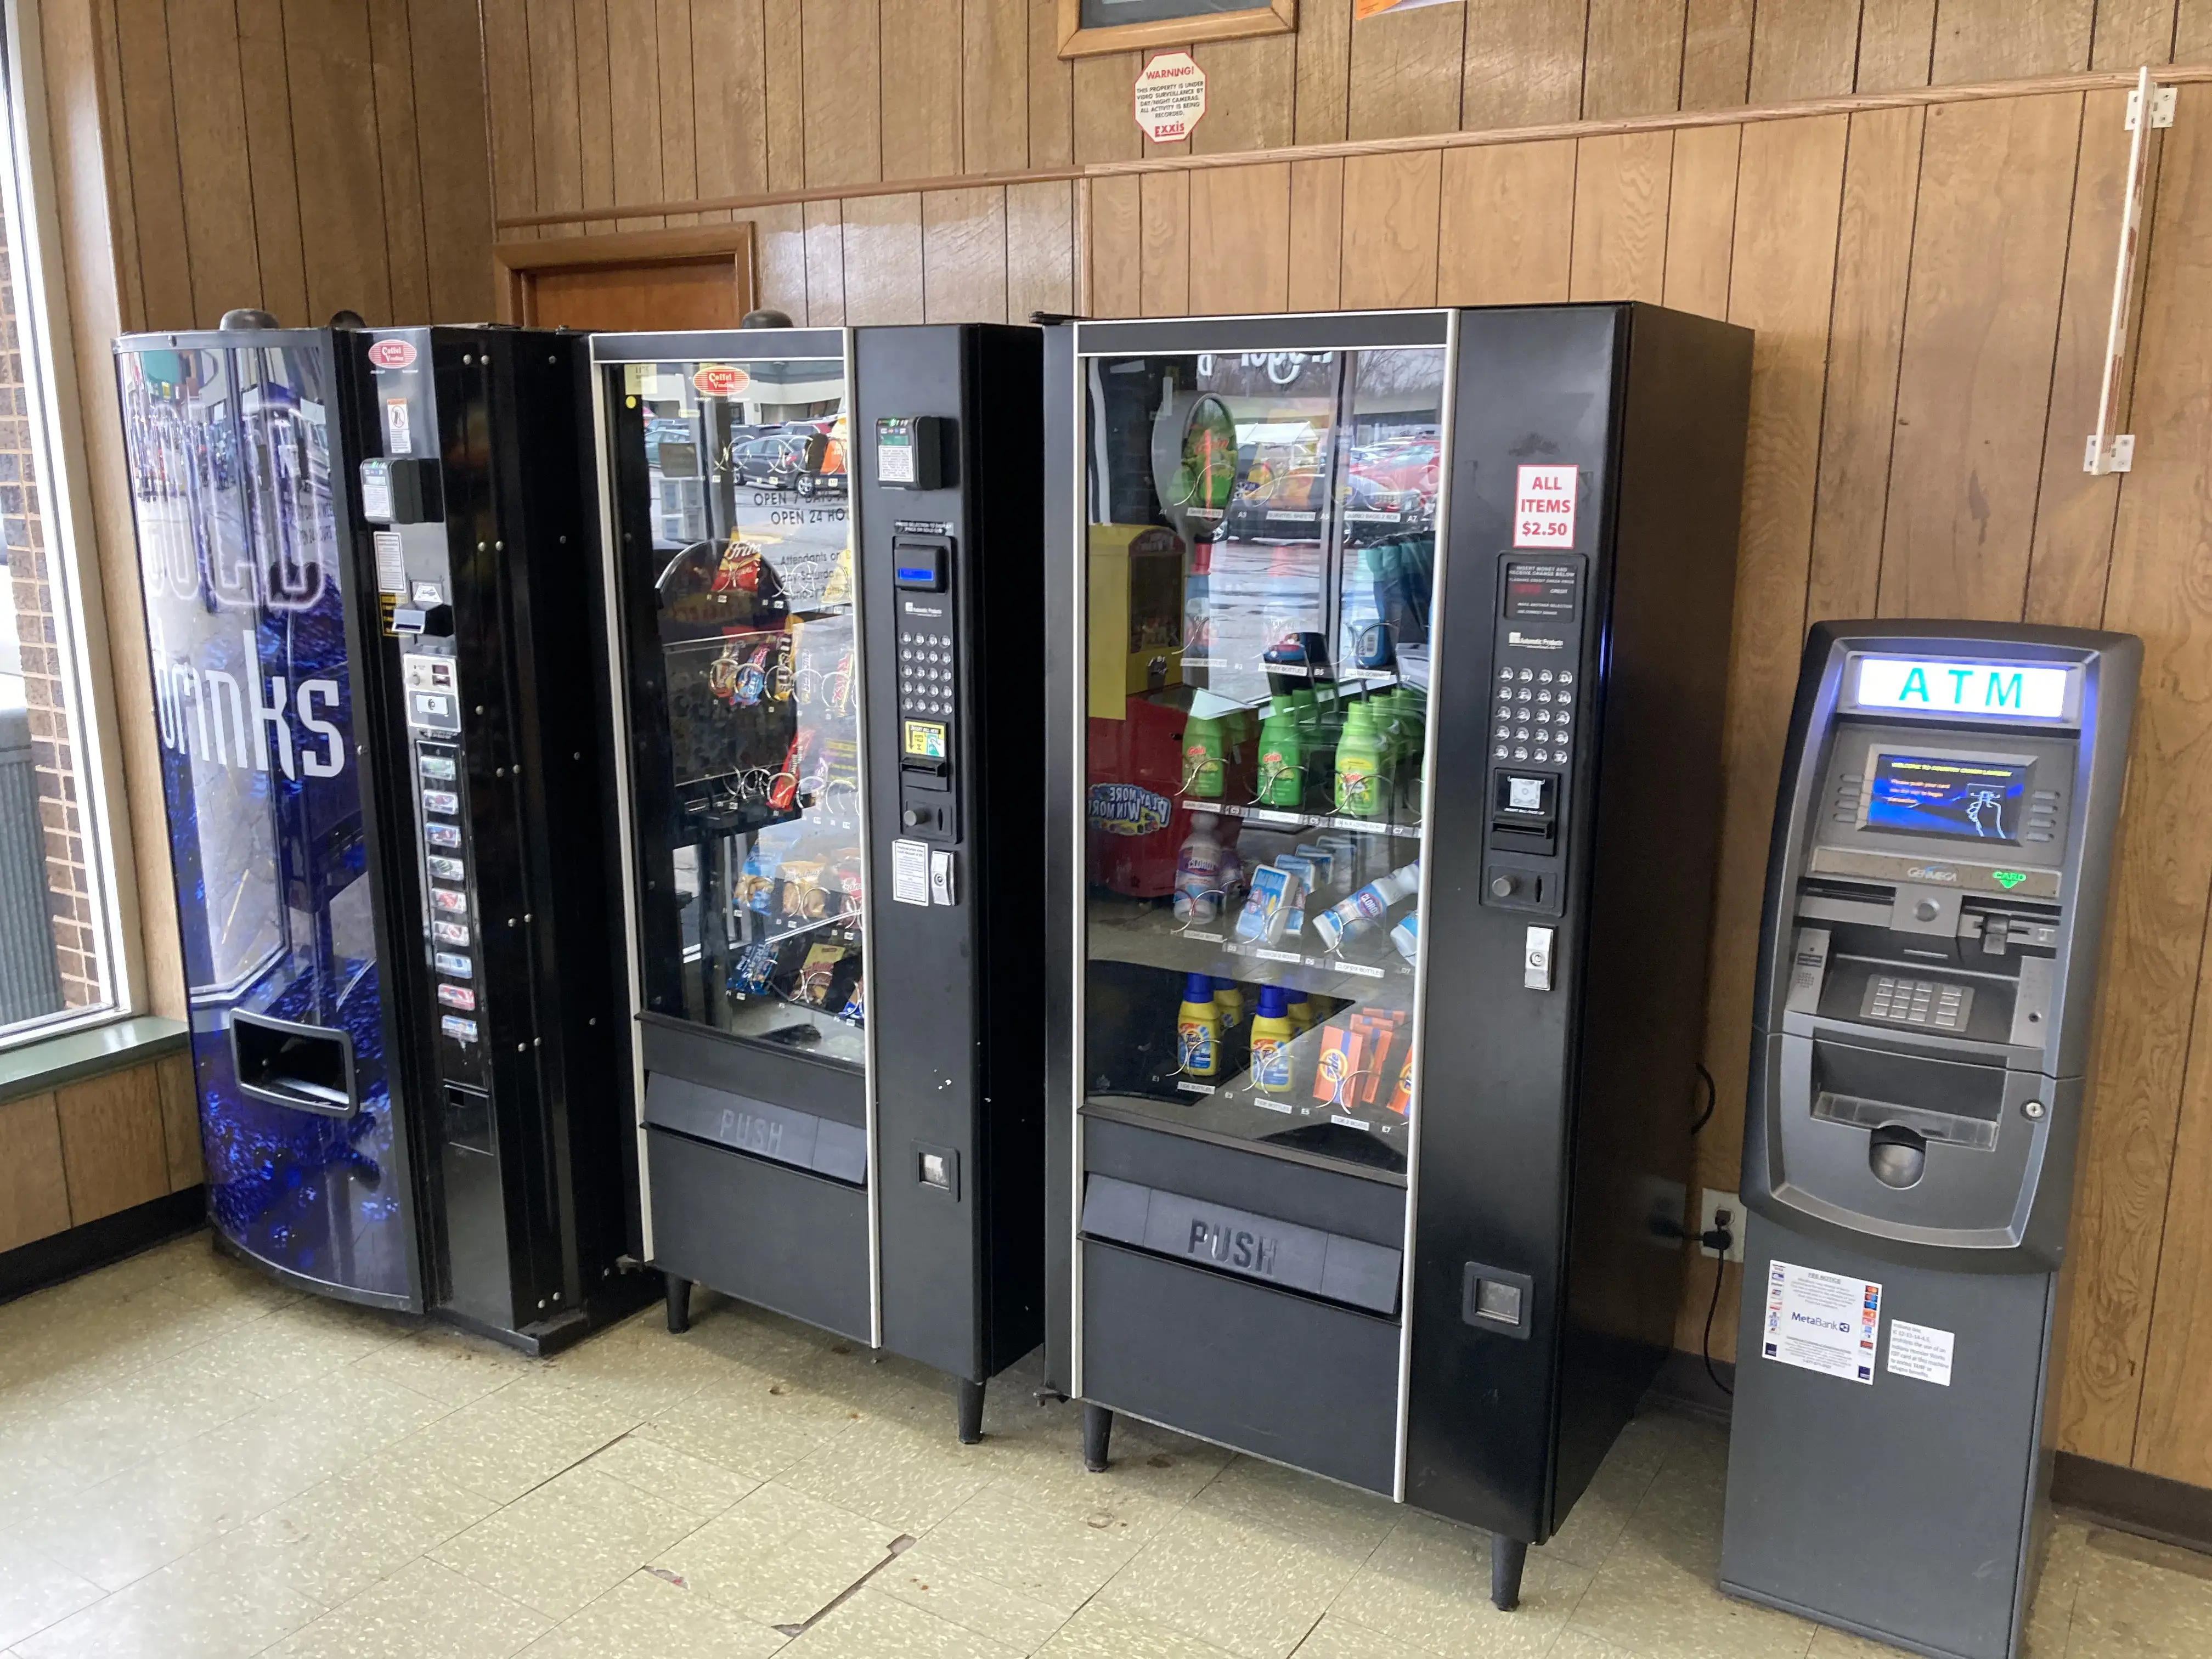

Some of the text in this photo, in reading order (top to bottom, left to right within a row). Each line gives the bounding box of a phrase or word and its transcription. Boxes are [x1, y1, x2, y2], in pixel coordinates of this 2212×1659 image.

[1146, 66, 1194, 80] WARNING!
[1155, 89, 1194, 99] SURVEILLANCE
[1140, 99, 1170, 107] DAY/NIGHT
[709, 373, 732, 382] Coffel
[1532, 476, 1562, 490] ALL
[754, 492, 786, 506] OPEN
[1521, 499, 1571, 513] ITEMS
[771, 510, 804, 525] OPEN
[809, 510, 822, 524] 24
[1522, 521, 1567, 536] $2.50
[1899, 667, 2023, 709] ATM
[1188, 746, 1205, 755] Gain
[1263, 754, 1281, 763] Gain
[1993, 871, 2026, 882] CARD
[1361, 893, 1380, 917] CLOROX
[1358, 967, 1384, 977] BOTTLES
[1186, 1034, 1201, 1043] Tide
[719, 1108, 783, 1155] PUSH
[1187, 1217, 1278, 1276] PUSH
[1820, 1274, 1842, 1284] NOTICE
[1791, 1312, 1838, 1331] MetaBank
